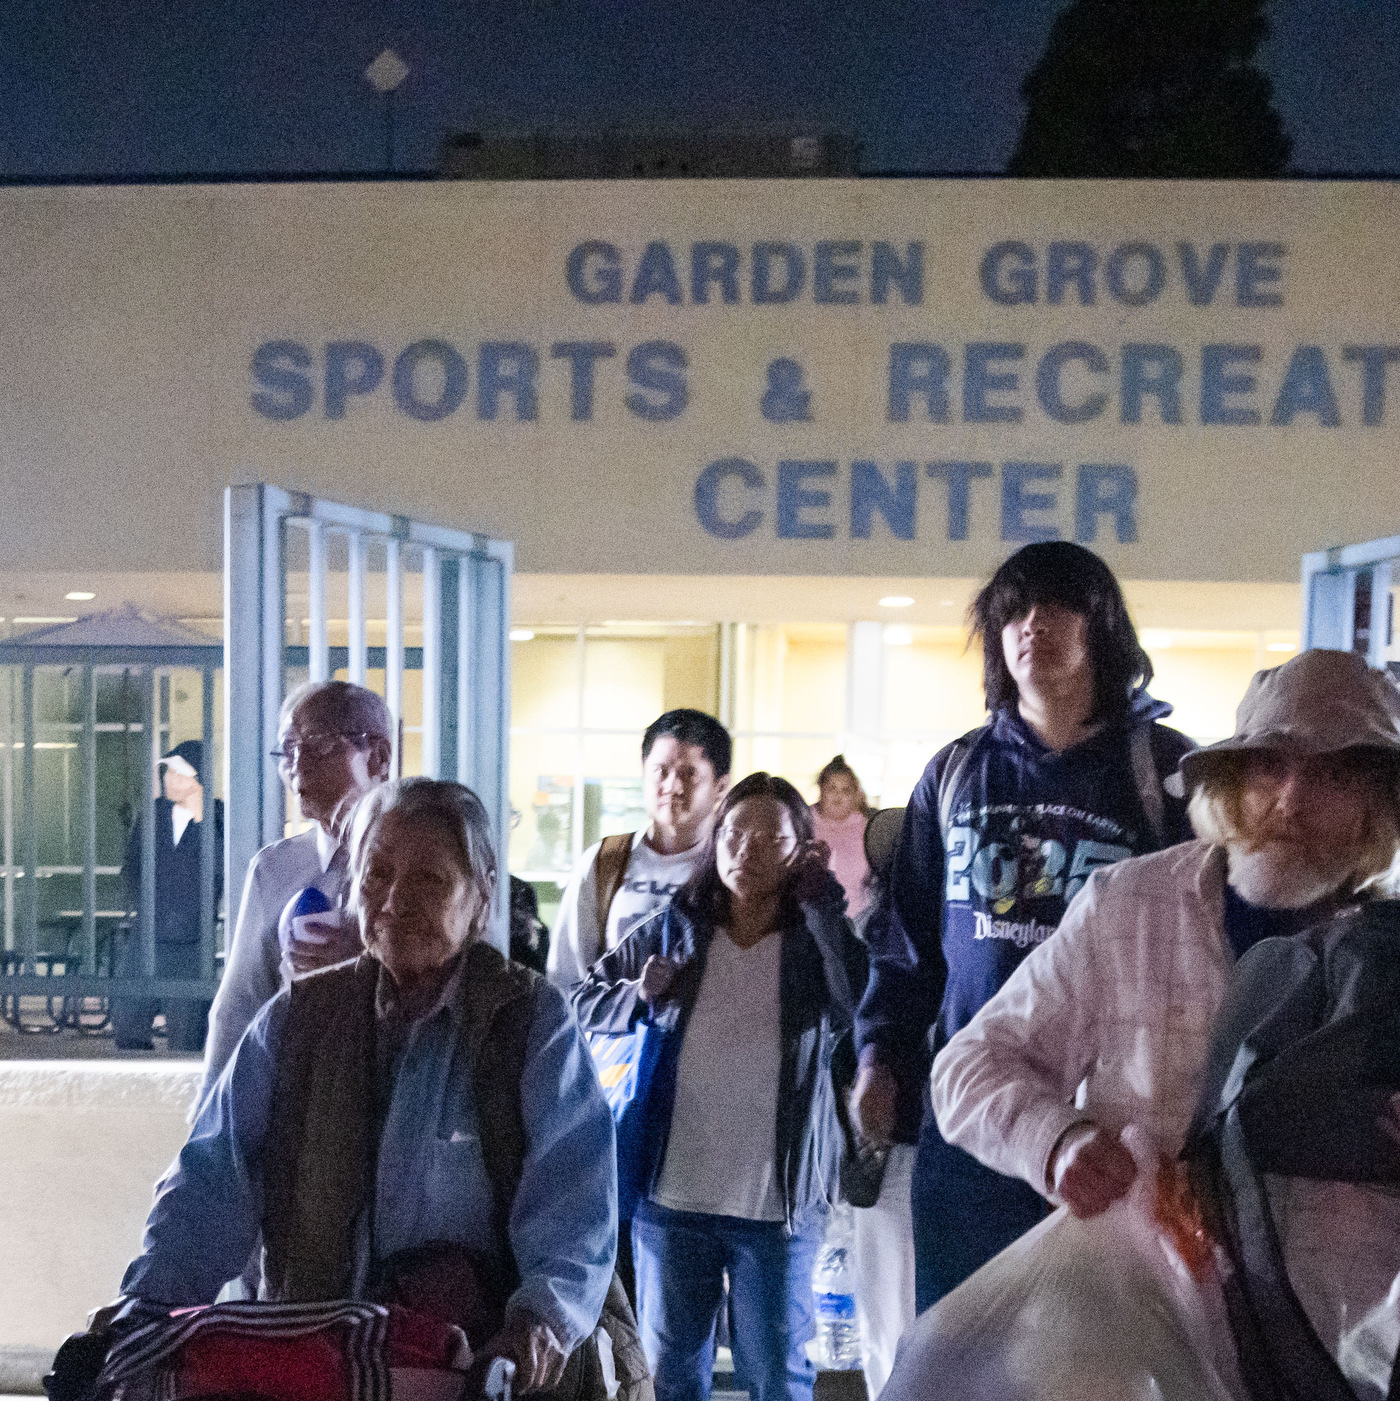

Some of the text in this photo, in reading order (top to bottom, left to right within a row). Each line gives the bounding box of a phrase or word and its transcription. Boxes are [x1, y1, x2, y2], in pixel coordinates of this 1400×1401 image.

[565, 238, 1287, 308] GARDEN GROVE
[250, 338, 689, 424] SPORTS
[760, 355, 813, 424] &
[693, 457, 1140, 545] CENTER
[973, 911, 1056, 948] Disneylan
